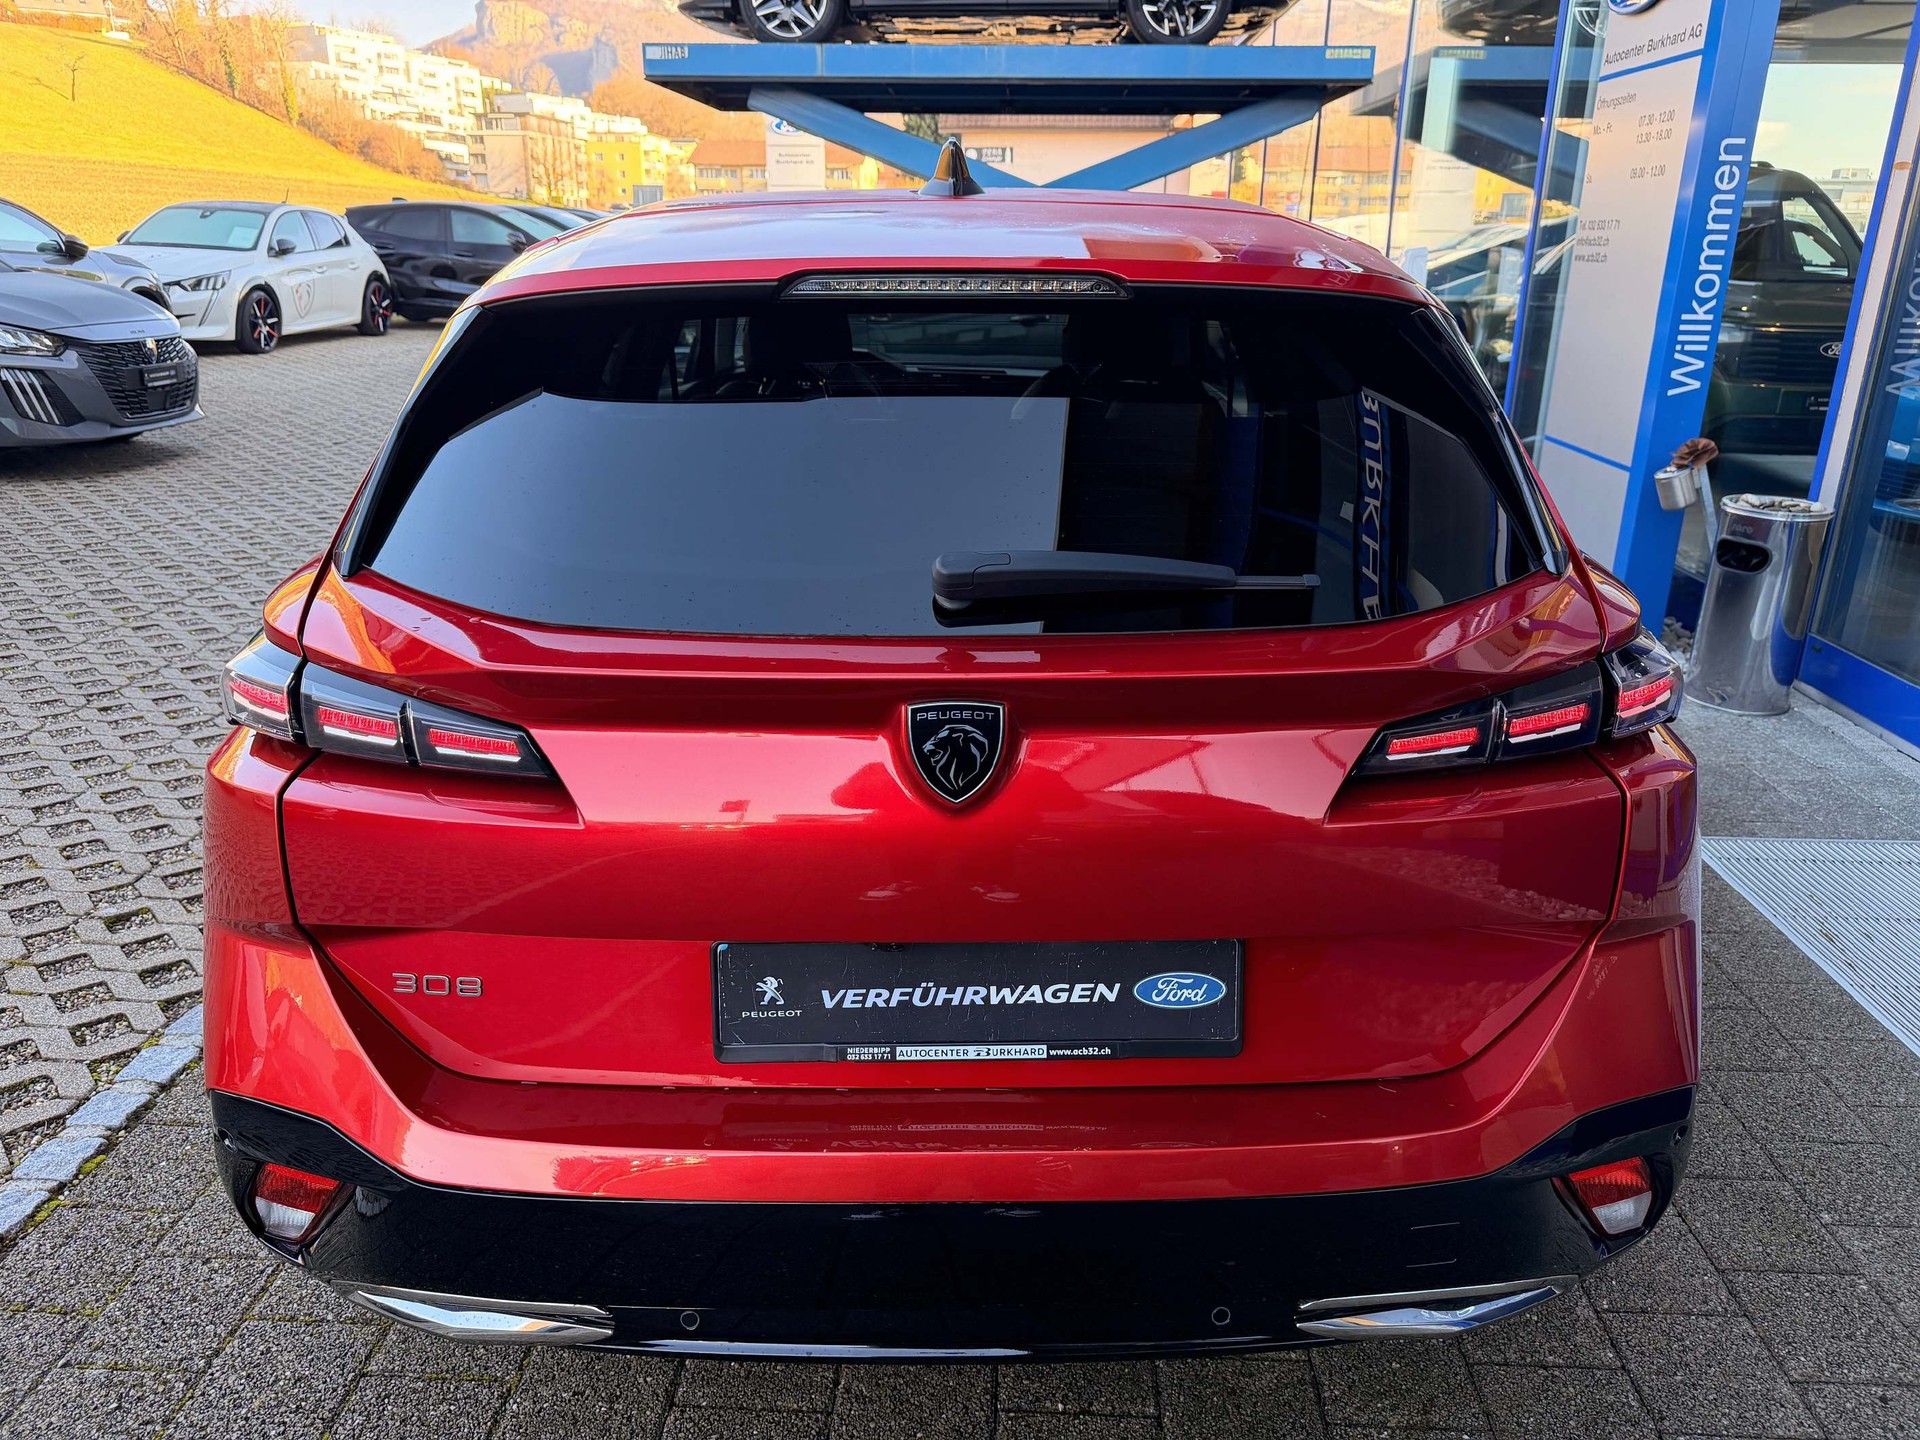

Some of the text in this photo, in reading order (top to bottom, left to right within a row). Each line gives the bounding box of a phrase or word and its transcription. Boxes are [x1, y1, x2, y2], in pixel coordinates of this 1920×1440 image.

[1603, 23, 1703, 66] Autocenter Burkhard AG
[1667, 137, 1747, 396] Willkommen
[917, 710, 995, 722] PEUGEOT
[392, 972, 483, 998] 308
[821, 982, 1121, 1009] VERFÜHRWAGEN
[741, 1009, 803, 1018] PEUGEOT
[897, 1047, 1045, 1058] AUTOCENTER BURKHARD
[1049, 1047, 1111, 1056] www.acb32.ch
